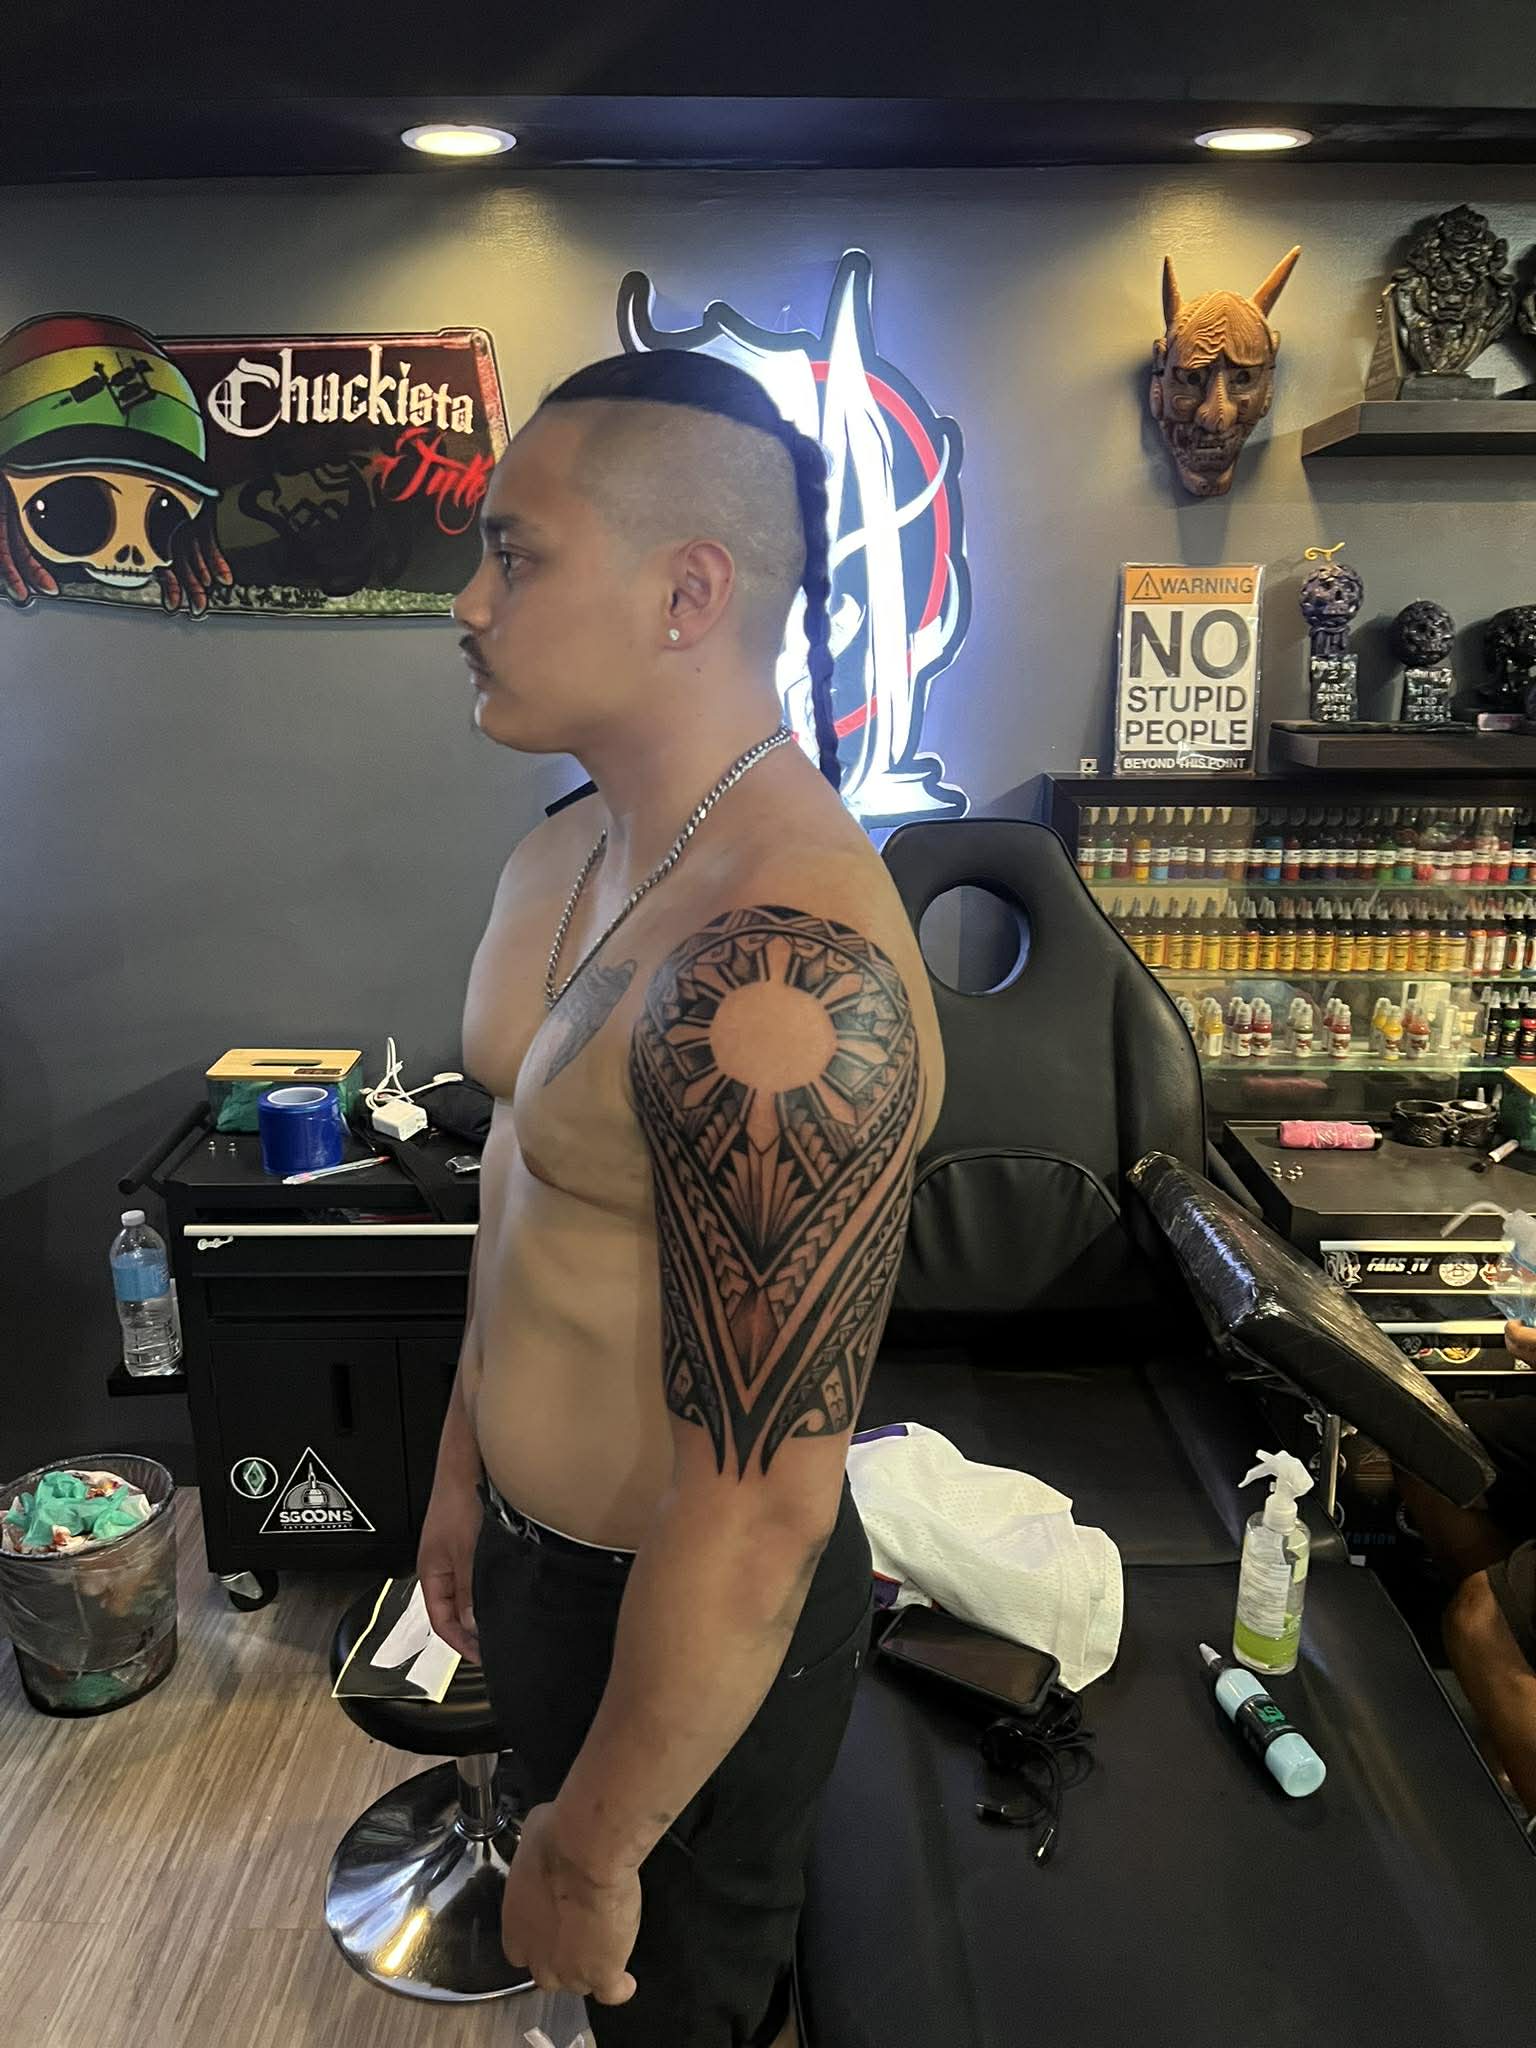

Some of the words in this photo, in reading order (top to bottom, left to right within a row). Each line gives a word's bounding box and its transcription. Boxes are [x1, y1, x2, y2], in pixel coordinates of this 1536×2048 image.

[207, 344, 474, 437] Chuckista
[1159, 577, 1254, 595] WARNING
[1128, 608, 1251, 680] NO
[1127, 685, 1248, 713] STUPID
[1125, 719, 1248, 745] PEOPLE
[1123, 757, 1176, 769] BEYOND
[1178, 757, 1206, 769] THIS
[1207, 757, 1247, 770] POINT
[1410, 1257, 1433, 1273] TV
[279, 1509, 353, 1523] SGOONS
